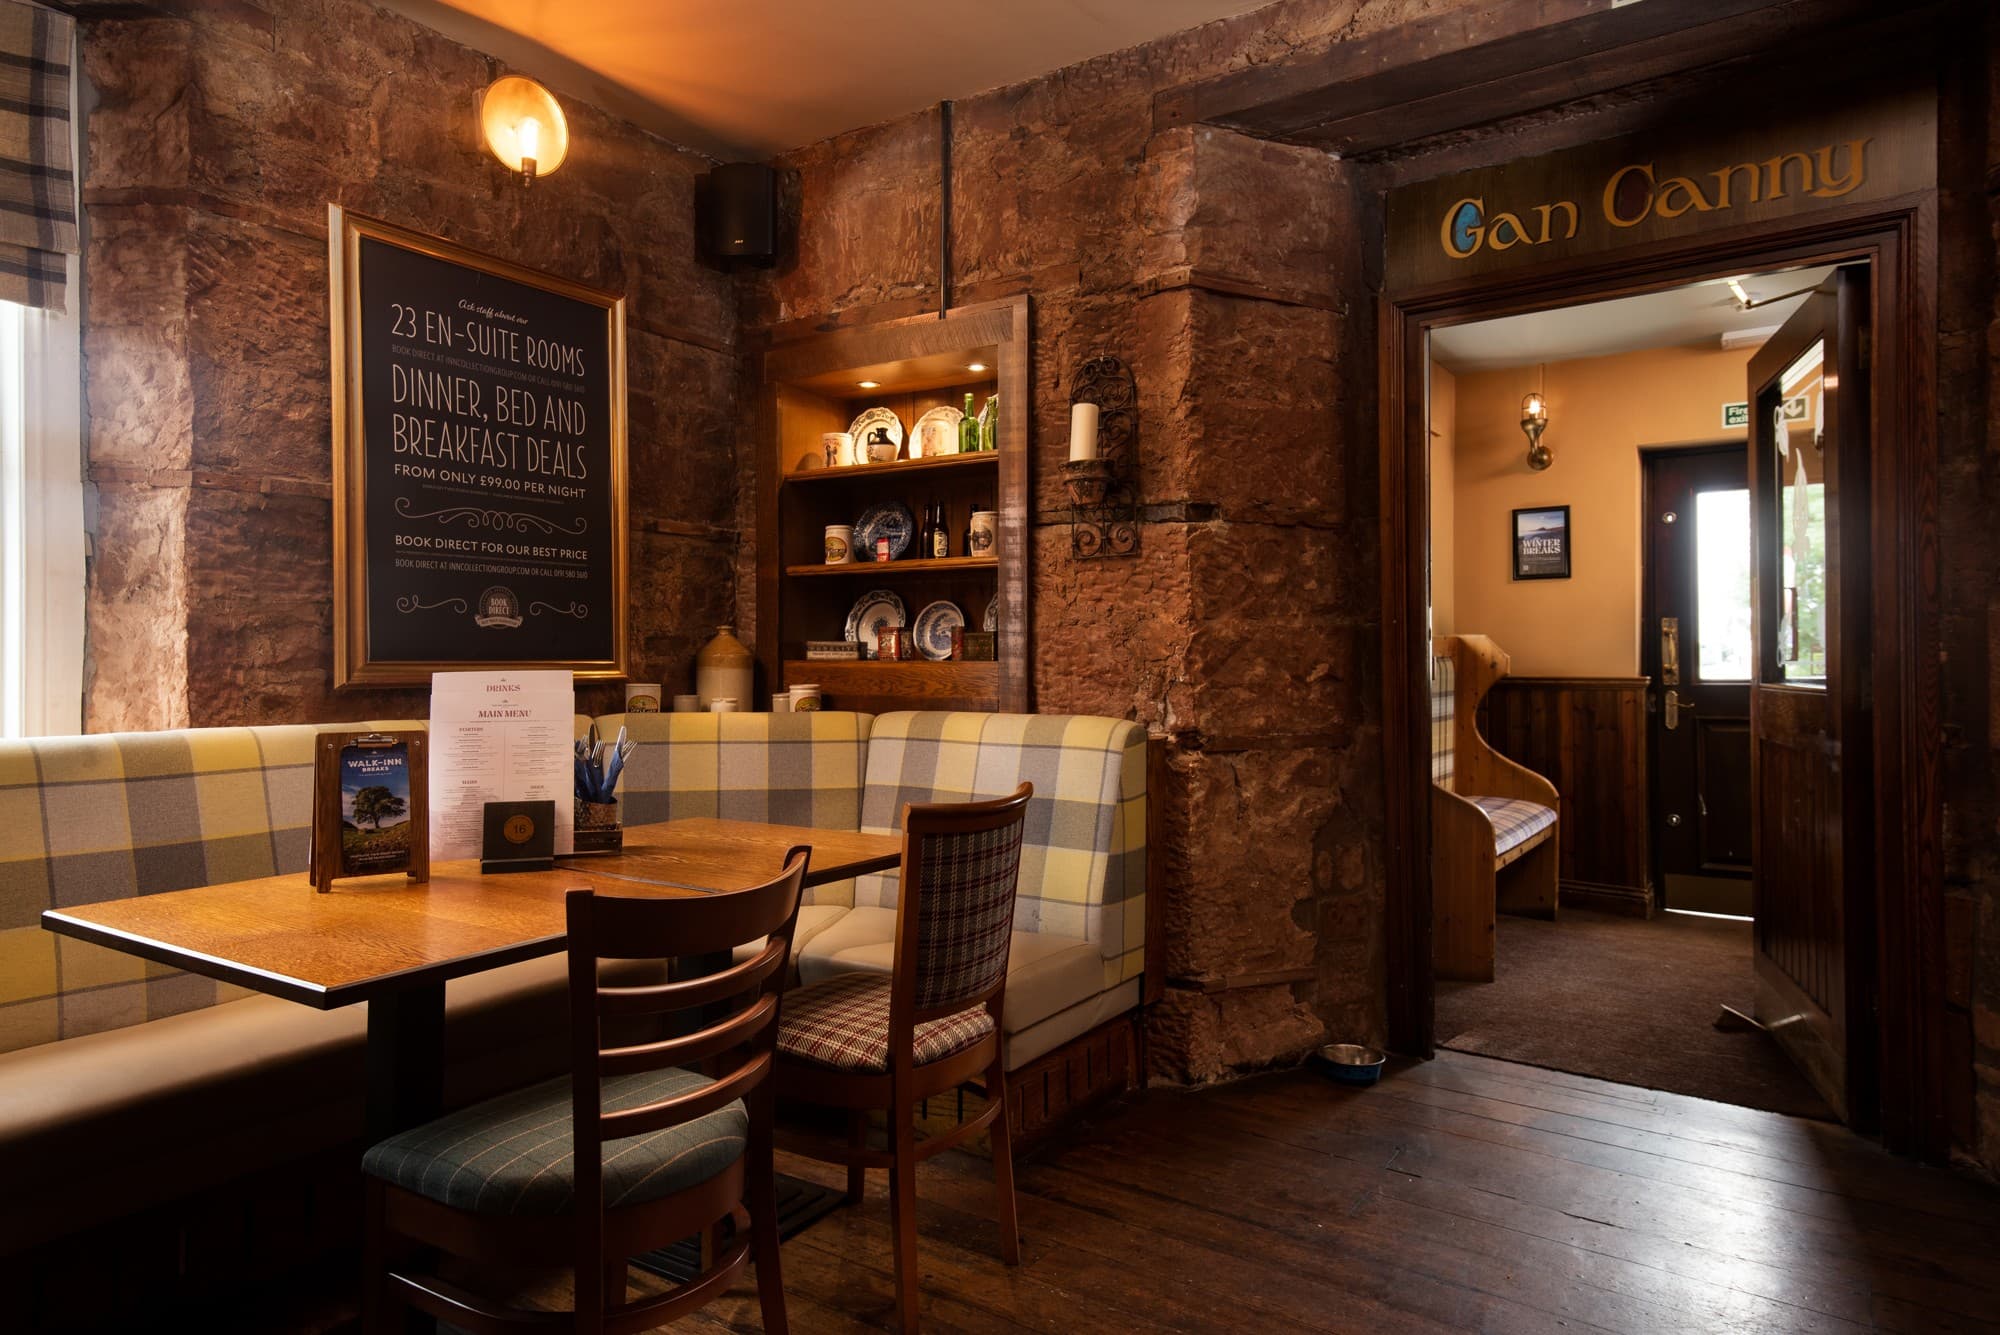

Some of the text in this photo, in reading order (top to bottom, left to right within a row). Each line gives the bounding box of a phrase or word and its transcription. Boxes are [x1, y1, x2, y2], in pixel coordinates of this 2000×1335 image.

[1441, 137, 1872, 260] Gan Canny
[458, 299, 529, 325] Ask staff about our
[391, 303, 585, 377] 23 EN-SUITE ROOMS
[411, 349, 434, 361] DIRECT
[392, 364, 586, 436] DINNER, BED AND
[393, 413, 587, 480] BREAKFAST DEALS
[395, 464, 435, 480] FROM
[441, 470, 477, 486] ONLY
[480, 474, 520, 491] £99.00
[524, 481, 545, 495] PER
[548, 485, 586, 499] NIGHT
[395, 535, 432, 548] BOOK
[435, 538, 478, 552] DIRECT
[481, 541, 503, 553] FOR
[506, 544, 530, 556] OUR
[532, 546, 557, 558] BEST
[560, 549, 588, 560] PRICE
[1522, 538, 1561, 548] WINTER
[1523, 545, 1561, 555] BREAKS
[395, 558, 414, 568] BOOK
[415, 560, 439, 569] DIRECT
[439, 561, 448, 570] AT
[540, 568, 553, 576] CALL
[491, 598, 508, 606] BOOK
[488, 606, 510, 616] DIRECT
[486, 684, 521, 692] DRINKS
[478, 710, 532, 718] MAIN MENU
[347, 758, 402, 768] WALK-INN
[513, 823, 527, 834] 16
